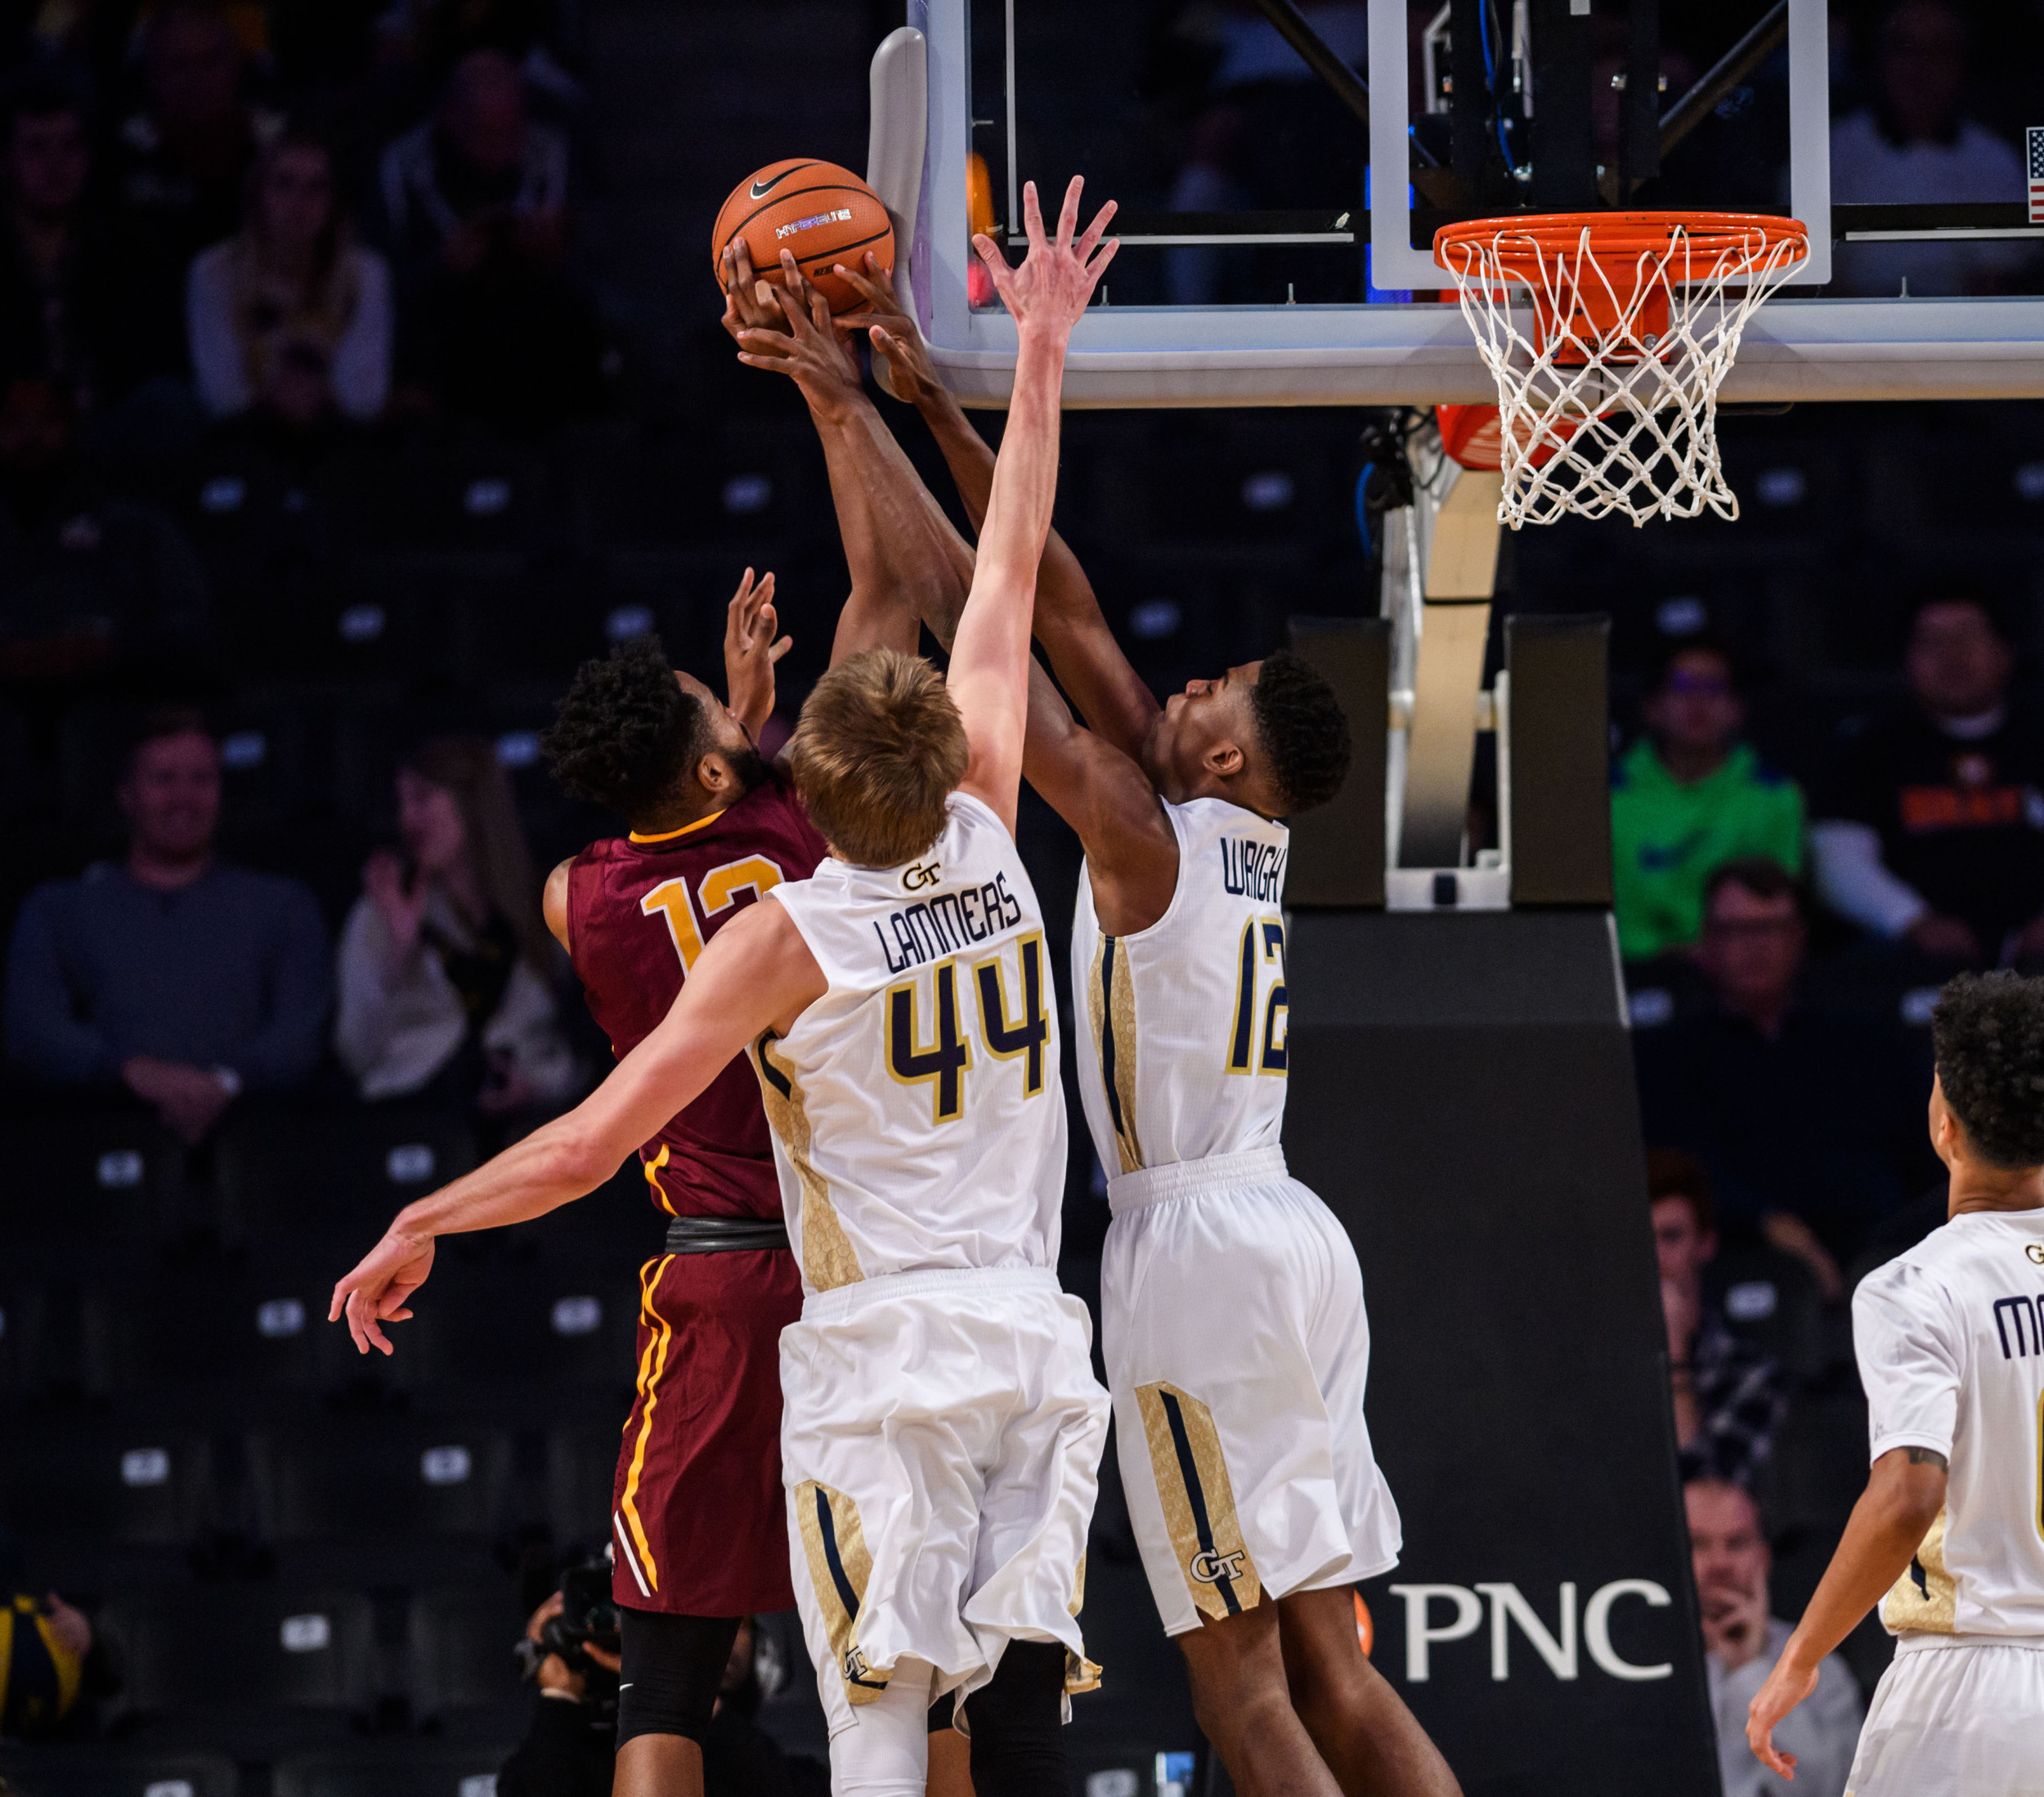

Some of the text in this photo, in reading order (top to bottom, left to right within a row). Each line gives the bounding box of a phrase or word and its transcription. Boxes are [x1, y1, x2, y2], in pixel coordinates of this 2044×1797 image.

[775, 208, 852, 239] HYPERELITE
[901, 862, 942, 892] GT
[1220, 836, 1288, 903] WRIGH
[873, 870, 1022, 974] LAMMERS
[885, 930, 1051, 1127] 44
[1190, 1548, 1246, 1584] GT
[1389, 1578, 1674, 1683] PNC
